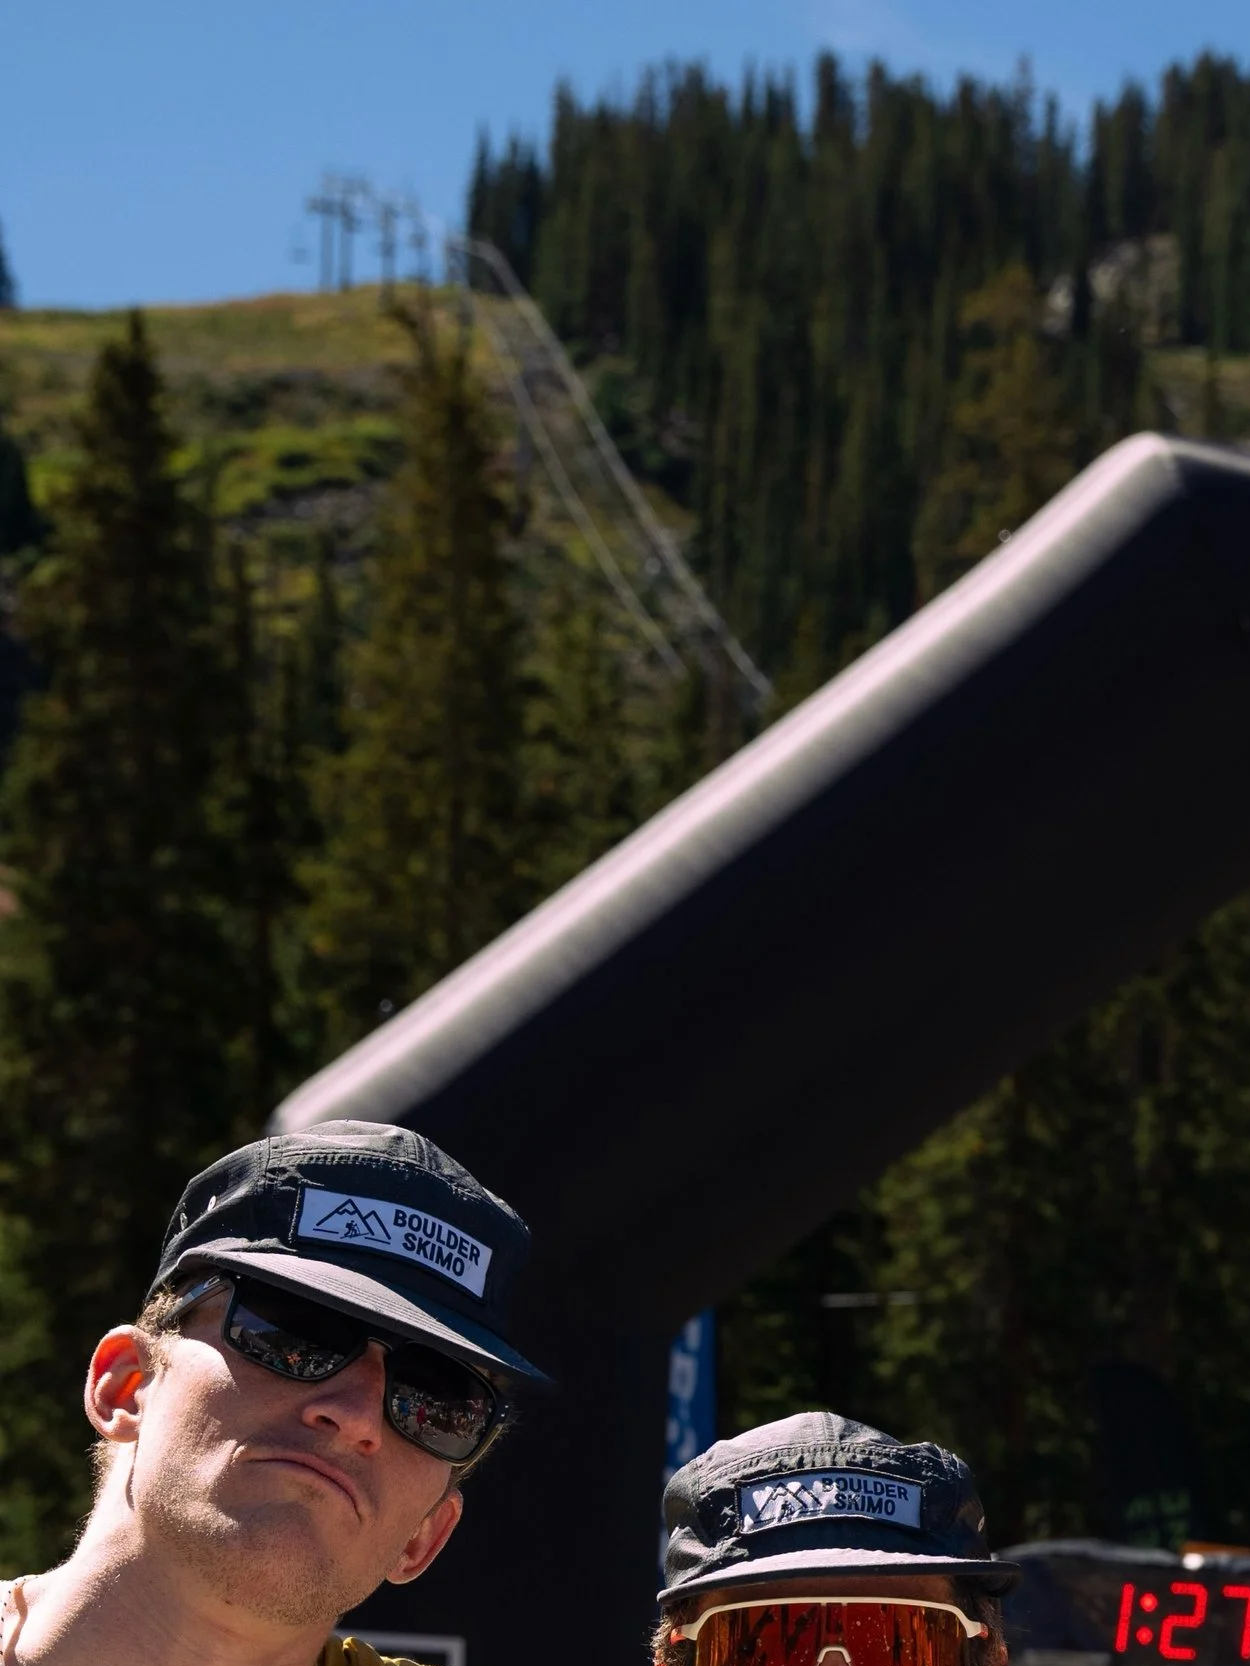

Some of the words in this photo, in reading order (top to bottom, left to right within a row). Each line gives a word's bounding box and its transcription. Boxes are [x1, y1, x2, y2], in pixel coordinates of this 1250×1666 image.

[393, 1209, 481, 1266] BOULDER
[402, 1233, 466, 1277] SKIMO
[821, 1477, 909, 1501] BOULDER
[834, 1493, 896, 1516] SKIMO
